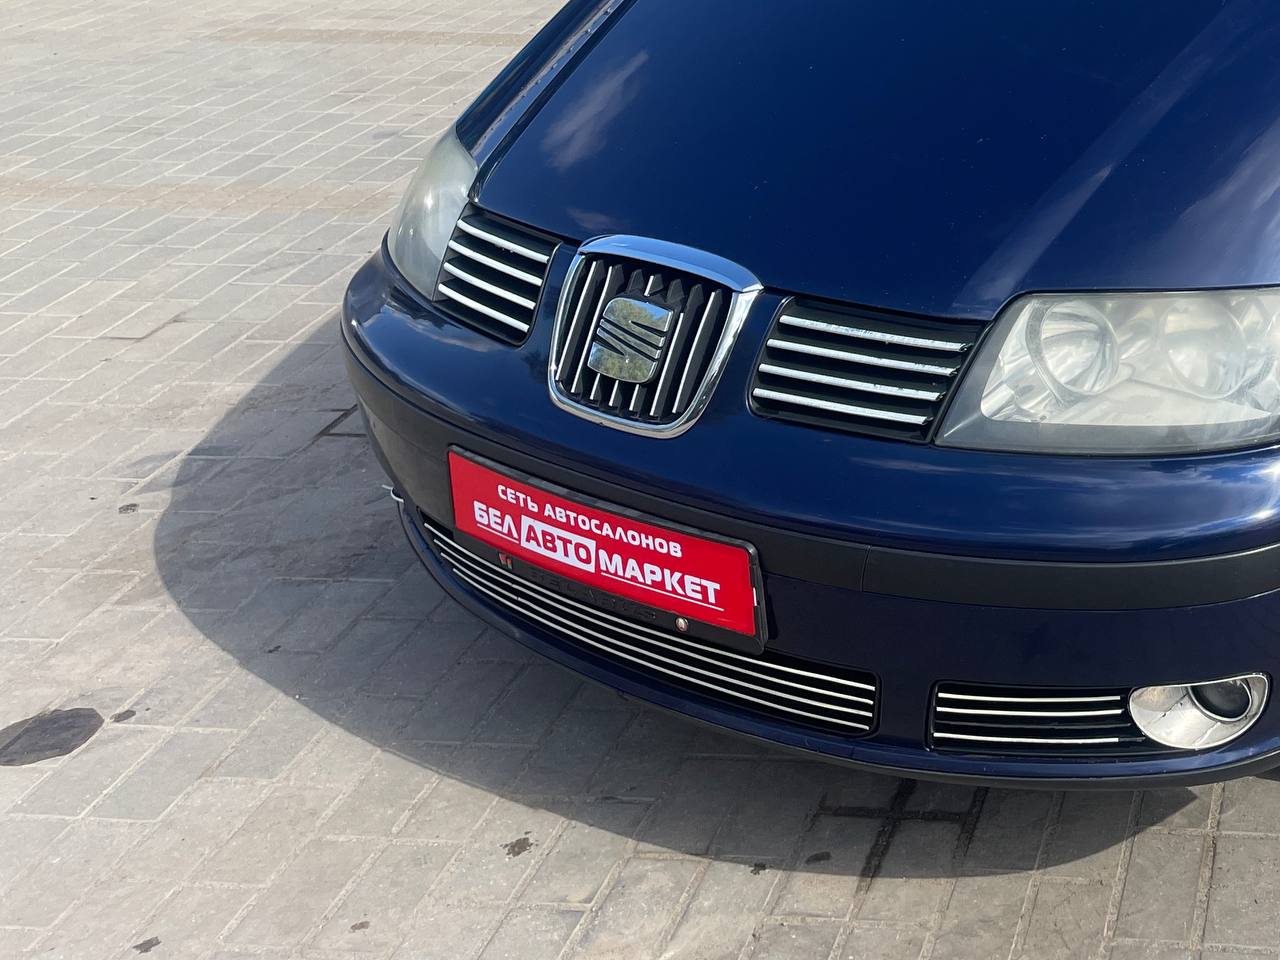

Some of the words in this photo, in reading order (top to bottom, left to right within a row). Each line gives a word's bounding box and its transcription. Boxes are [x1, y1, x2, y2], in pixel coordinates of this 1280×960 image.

[473, 500, 519, 540] БЕЛ
[525, 523, 594, 567] АВТО
[599, 549, 721, 604] МАРКЕТ
[497, 484, 540, 512] СЕТЬ
[543, 503, 684, 558] АВТОСАЛОНОВ
